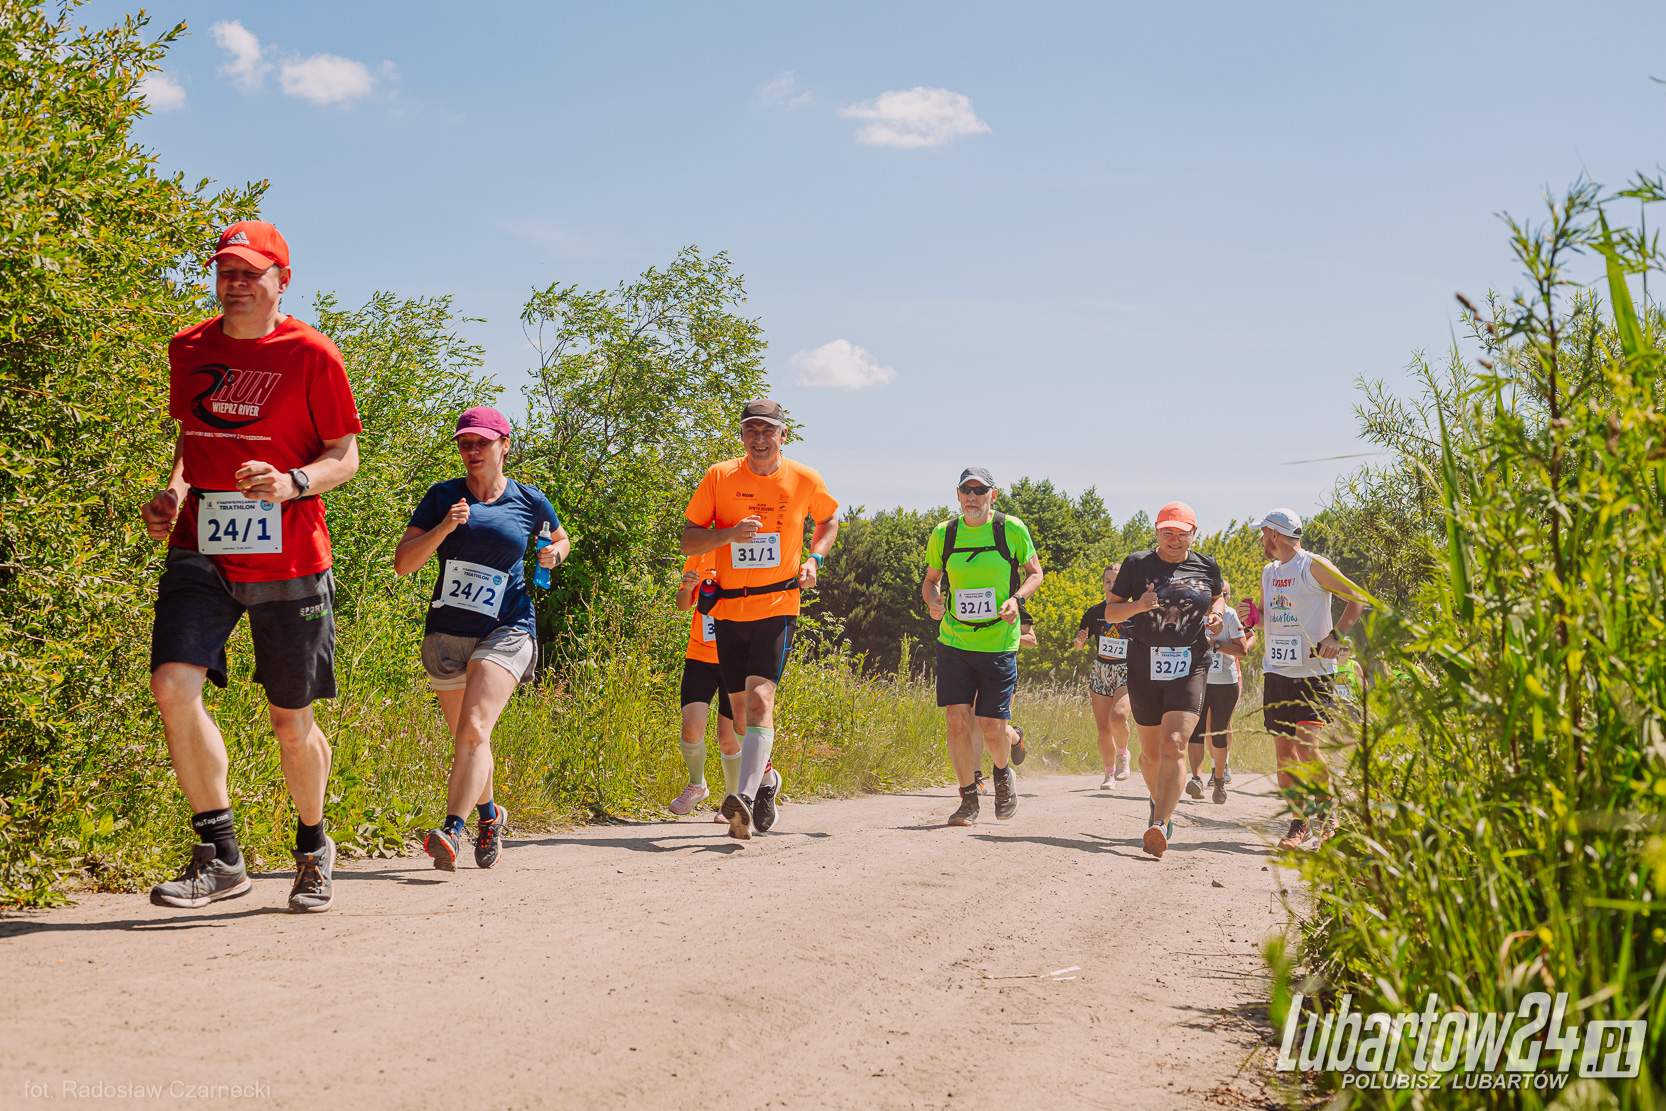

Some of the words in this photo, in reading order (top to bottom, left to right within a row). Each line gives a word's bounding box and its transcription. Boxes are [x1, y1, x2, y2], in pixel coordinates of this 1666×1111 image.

[210, 368, 282, 406] RUN
[212, 401, 238, 415] WIEPRZ
[238, 403, 260, 417] RIVER
[207, 517, 272, 542] 24/1
[738, 547, 775, 562] 31/1
[448, 579, 497, 607] 24/2
[960, 600, 992, 615] 32/1
[1102, 643, 1124, 655] 22/2
[1271, 647, 1297, 661] 35/1
[1155, 660, 1187, 674] 32/2
